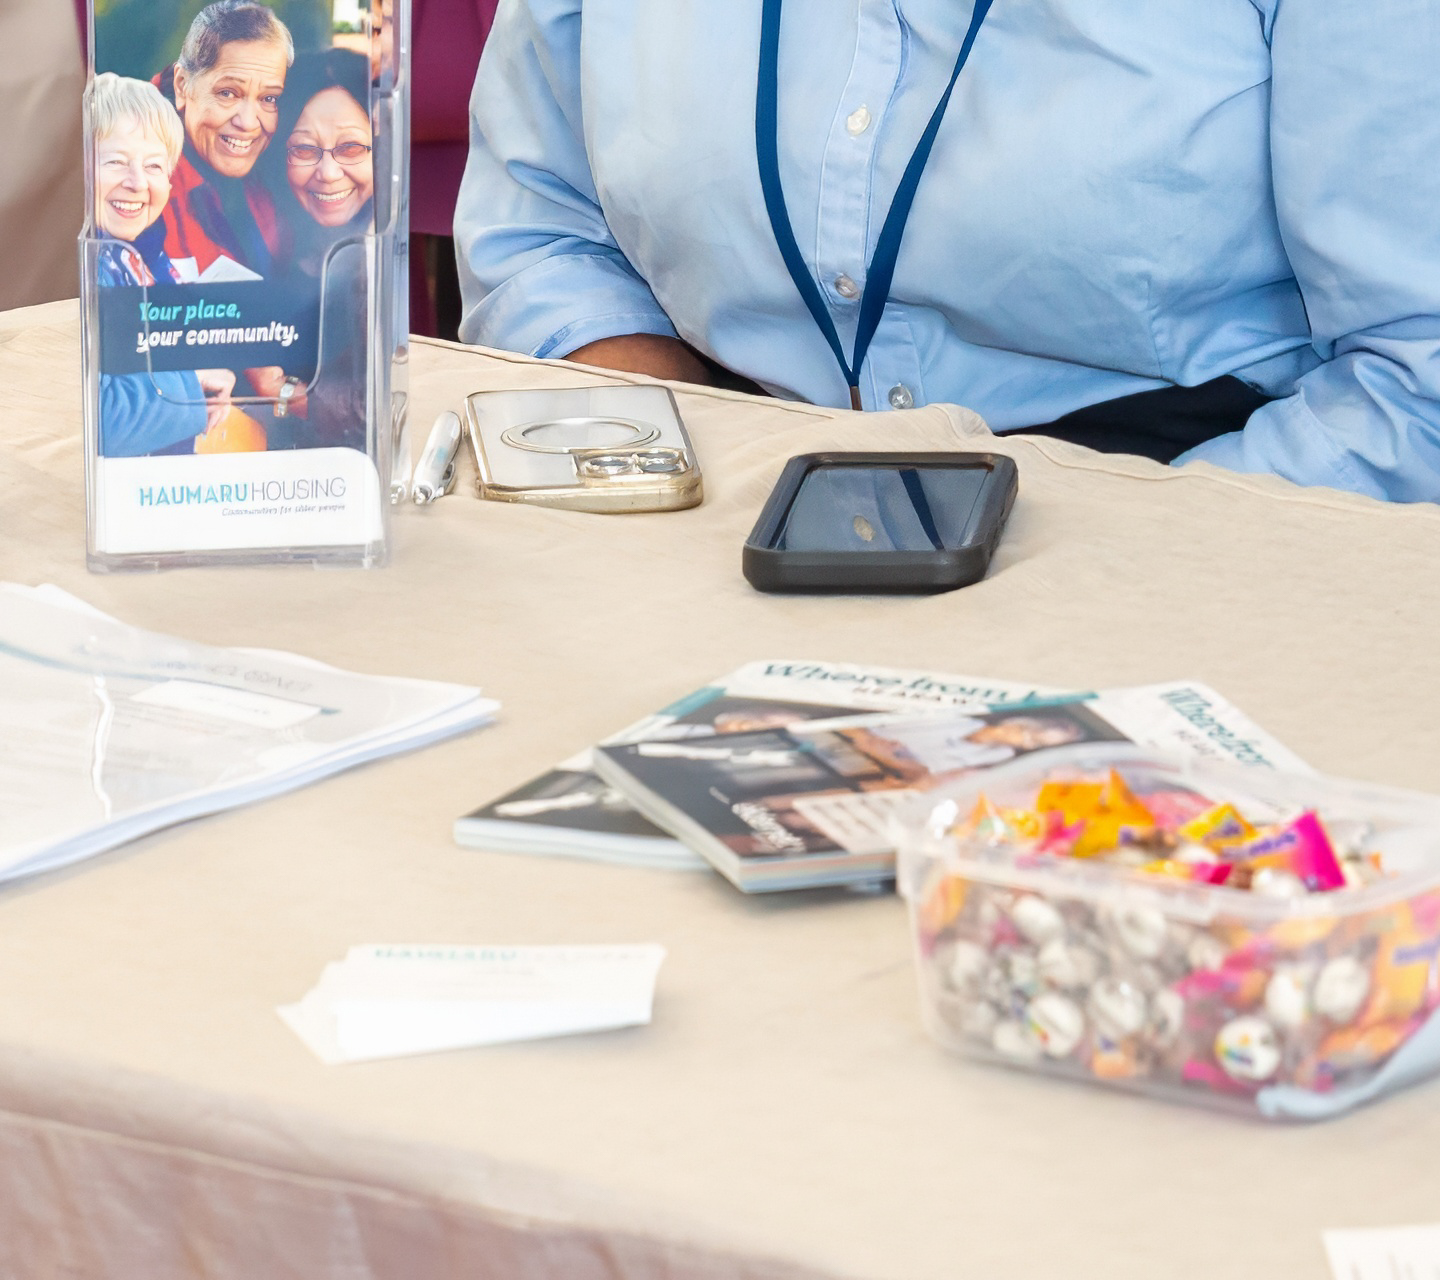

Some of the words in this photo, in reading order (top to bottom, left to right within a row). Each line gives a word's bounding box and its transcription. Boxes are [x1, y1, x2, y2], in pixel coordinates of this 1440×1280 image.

[139, 302, 183, 322] Your
[184, 299, 242, 326] place,
[136, 330, 183, 354] your
[185, 321, 299, 347] community.
[138, 483, 249, 507] HAUMARU
[251, 476, 347, 502] HOUSING
